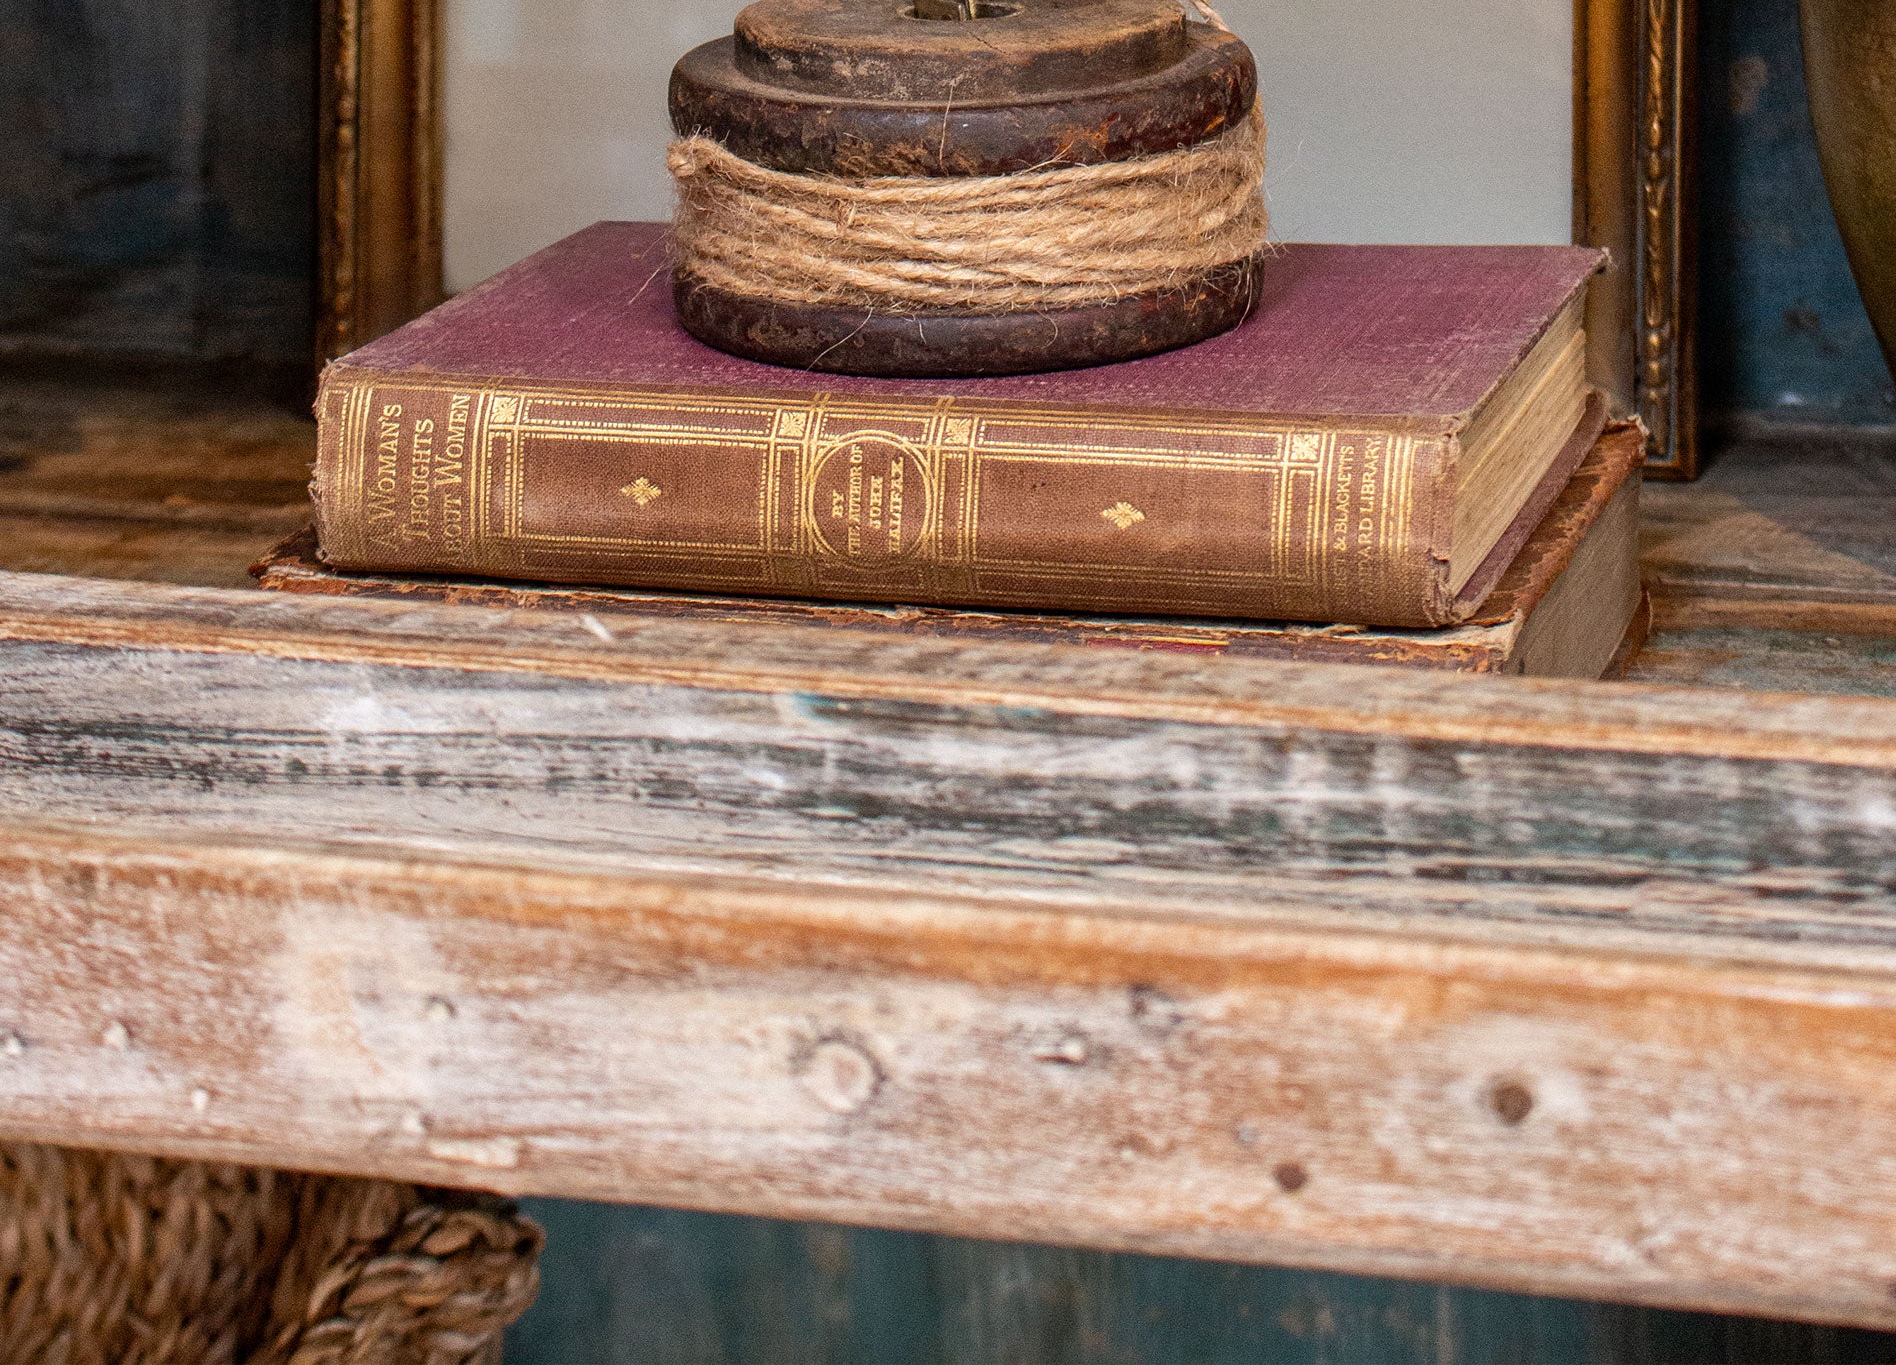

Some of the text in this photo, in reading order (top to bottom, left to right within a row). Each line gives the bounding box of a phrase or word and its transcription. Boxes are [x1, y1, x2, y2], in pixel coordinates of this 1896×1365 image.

[366, 403, 402, 524] WOMAN'S
[401, 418, 434, 542] THOUGHTS
[433, 393, 471, 489] WOMEN
[831, 489, 845, 519] BY
[848, 443, 863, 556] THE AUTHOR OF
[869, 475, 883, 530] JOHN
[888, 456, 904, 554] HALIFAX
[1333, 537, 1348, 553] &
